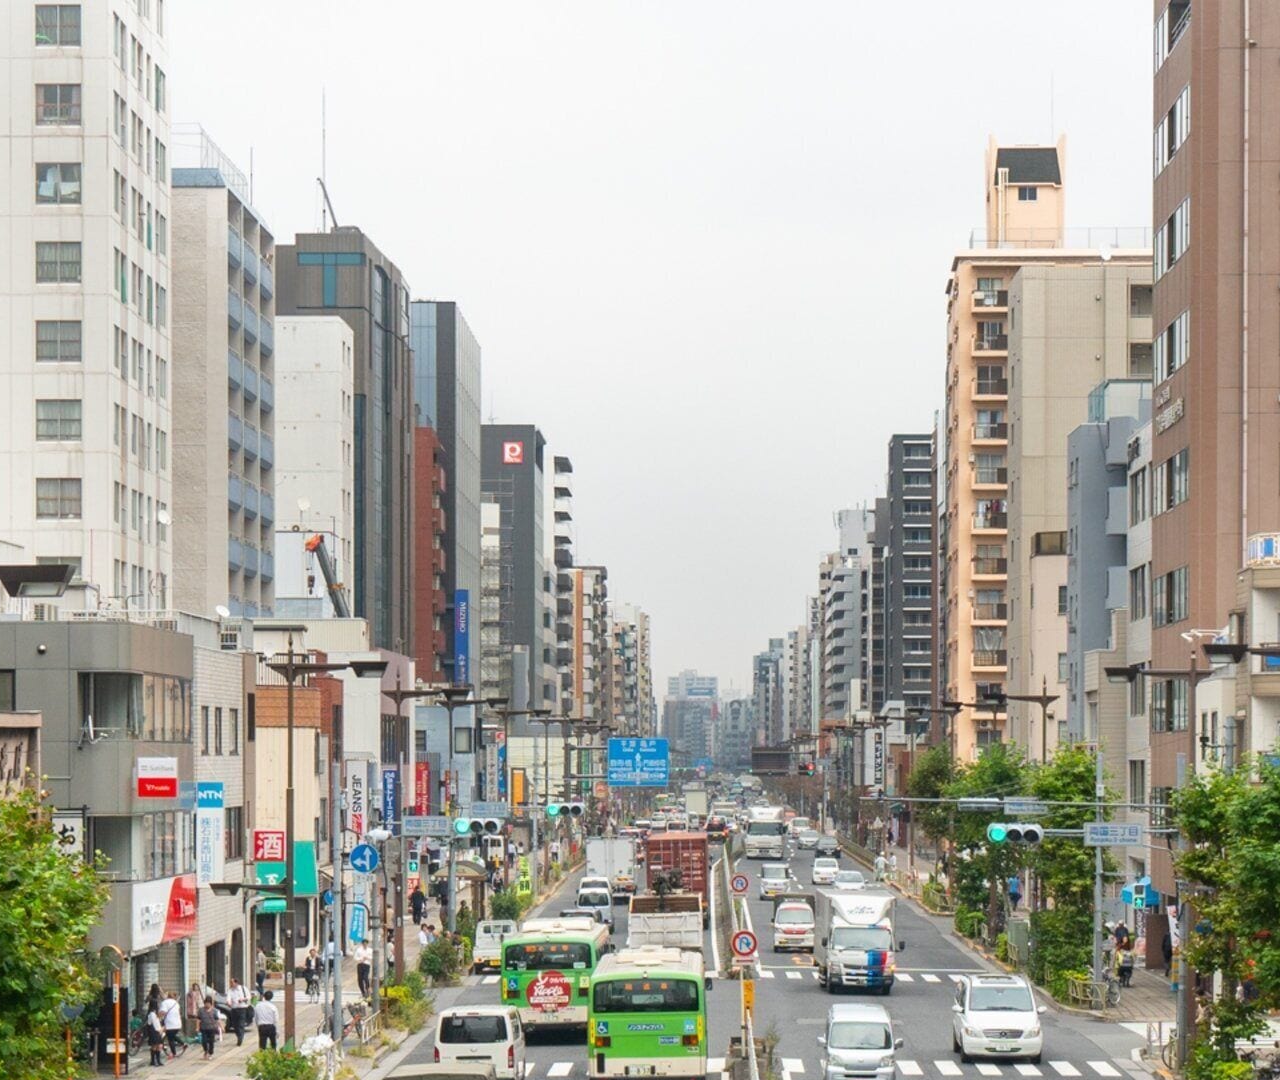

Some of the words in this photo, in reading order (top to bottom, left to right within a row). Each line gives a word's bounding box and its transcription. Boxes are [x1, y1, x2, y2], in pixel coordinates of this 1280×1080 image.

[198, 790, 223, 800] NTN
[352, 775, 362, 813] JEANS
[256, 832, 284, 860] 酒
